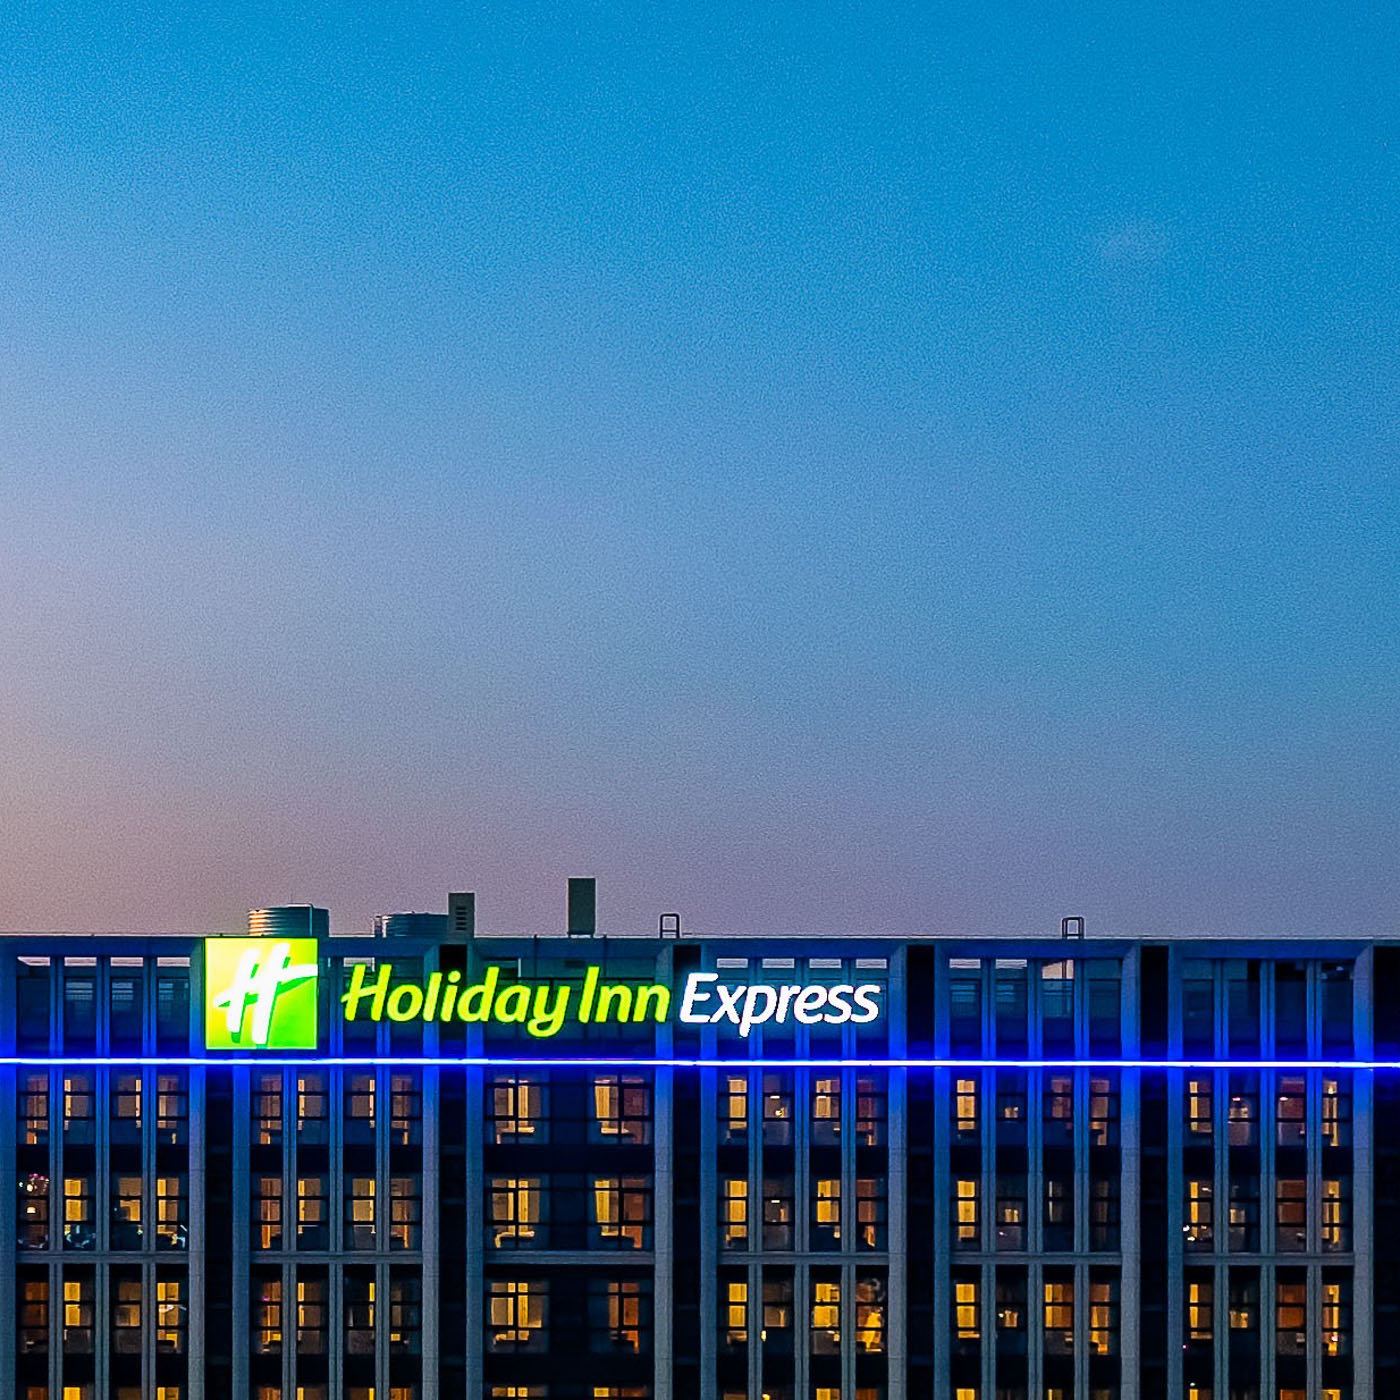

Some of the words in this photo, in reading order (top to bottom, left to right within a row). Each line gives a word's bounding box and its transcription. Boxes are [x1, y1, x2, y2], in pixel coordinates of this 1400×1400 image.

[341, 963, 570, 1038] Holiday
[579, 966, 671, 1023] Inn
[680, 972, 882, 1038] Express
